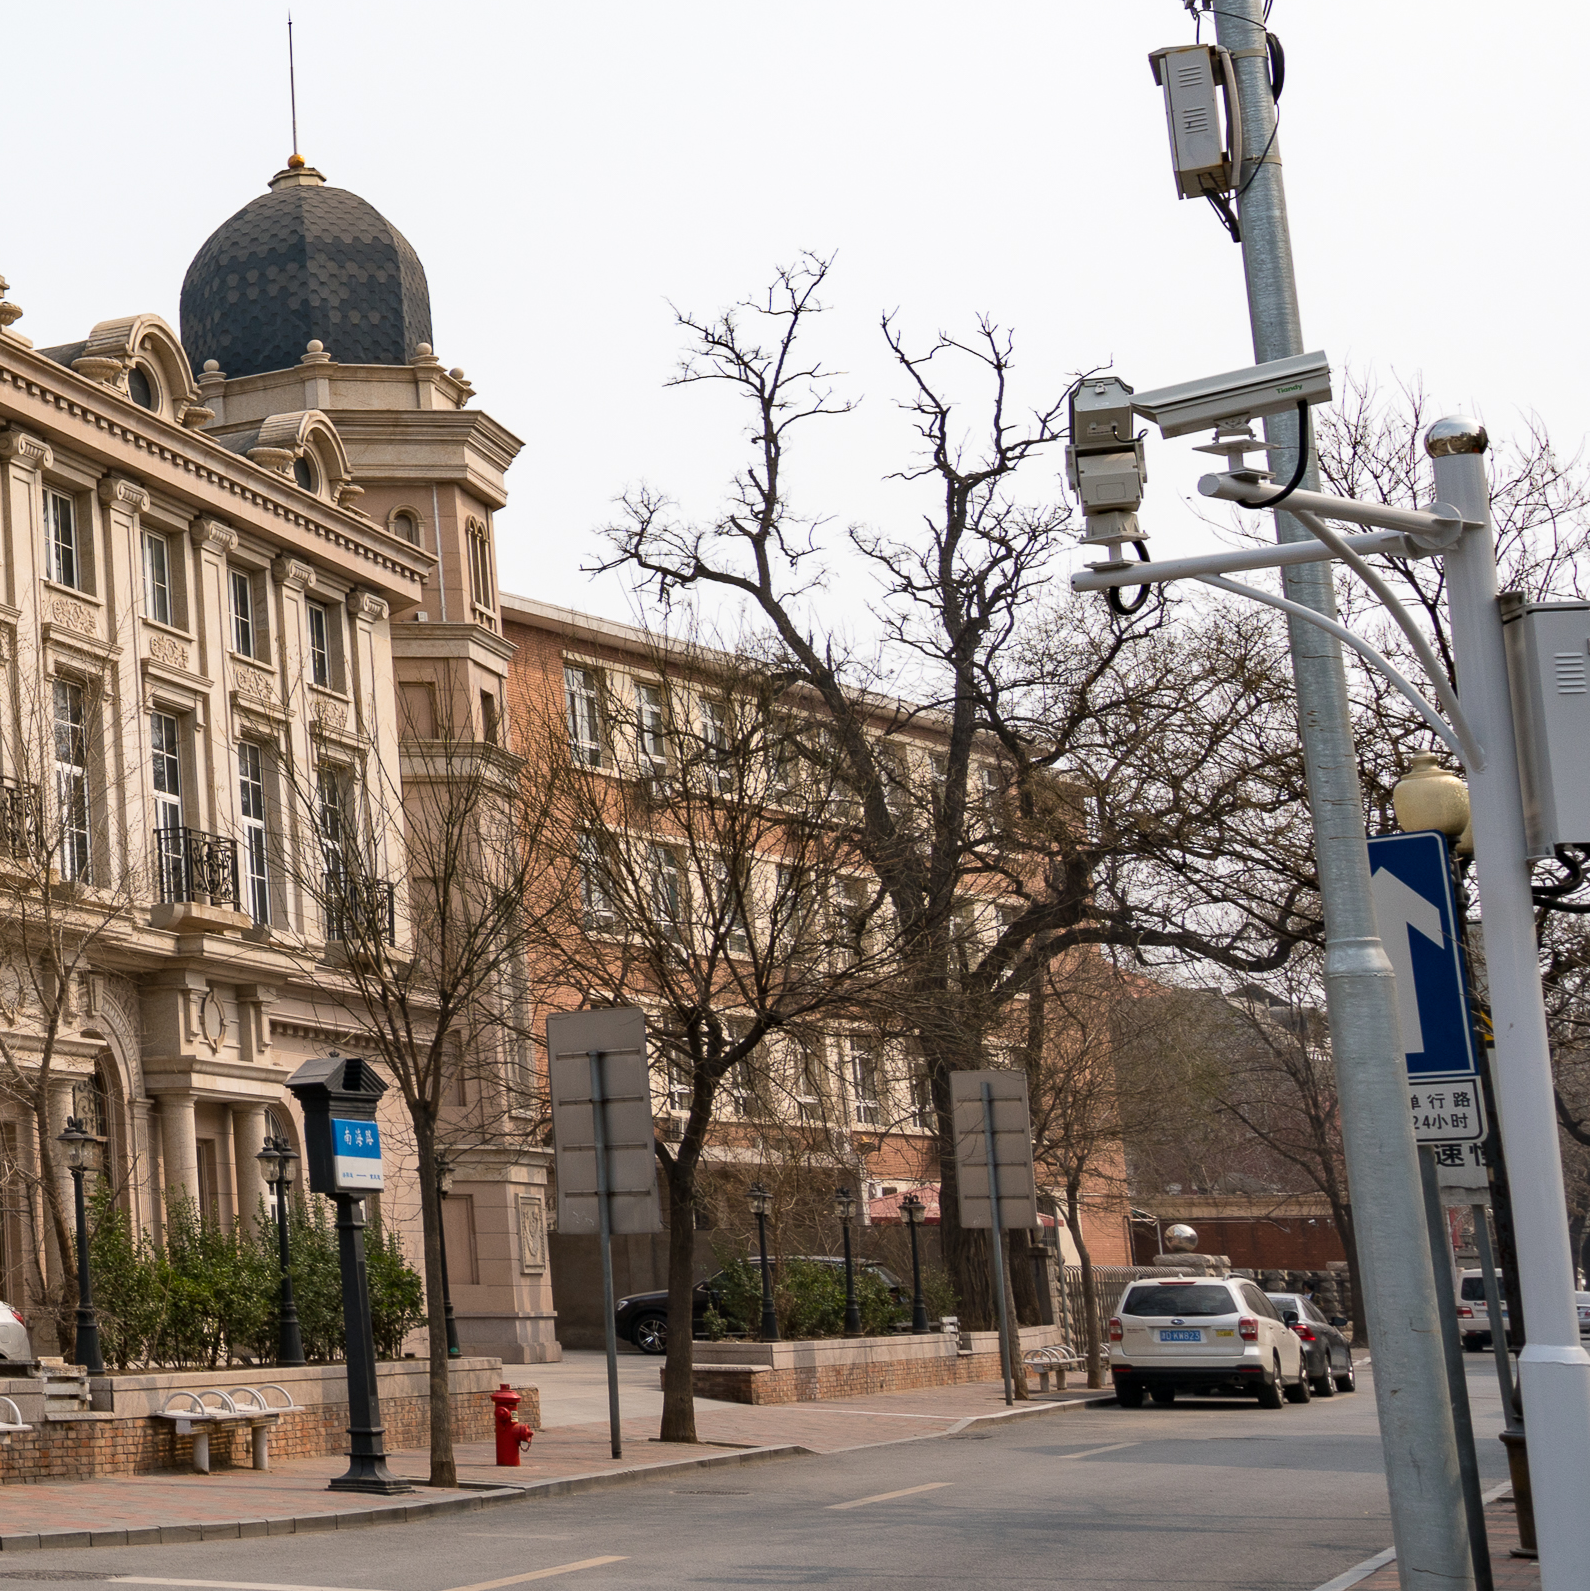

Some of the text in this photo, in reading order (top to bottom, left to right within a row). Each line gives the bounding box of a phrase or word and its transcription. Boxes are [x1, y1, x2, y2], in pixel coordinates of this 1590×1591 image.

[1275, 384, 1303, 394] Tiandy
[344, 1125, 374, 1147] 南海路
